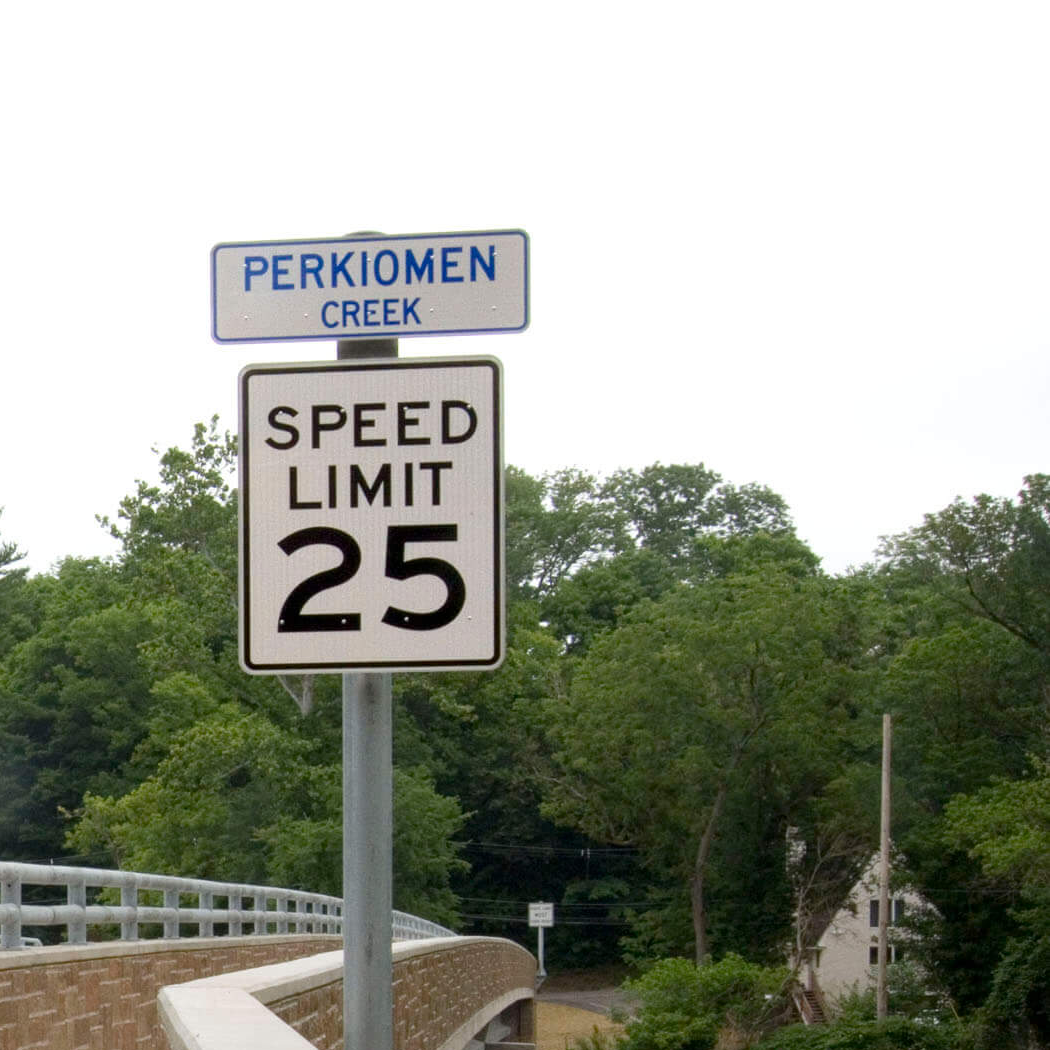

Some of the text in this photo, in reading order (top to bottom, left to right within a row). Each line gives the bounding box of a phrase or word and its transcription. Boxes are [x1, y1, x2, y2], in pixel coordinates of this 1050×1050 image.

[244, 245, 496, 291] PERKIOMEN
[321, 298, 421, 328] CREEK
[265, 401, 478, 449] SPEED
[289, 461, 453, 510] LIMIT
[277, 524, 466, 633] 25
